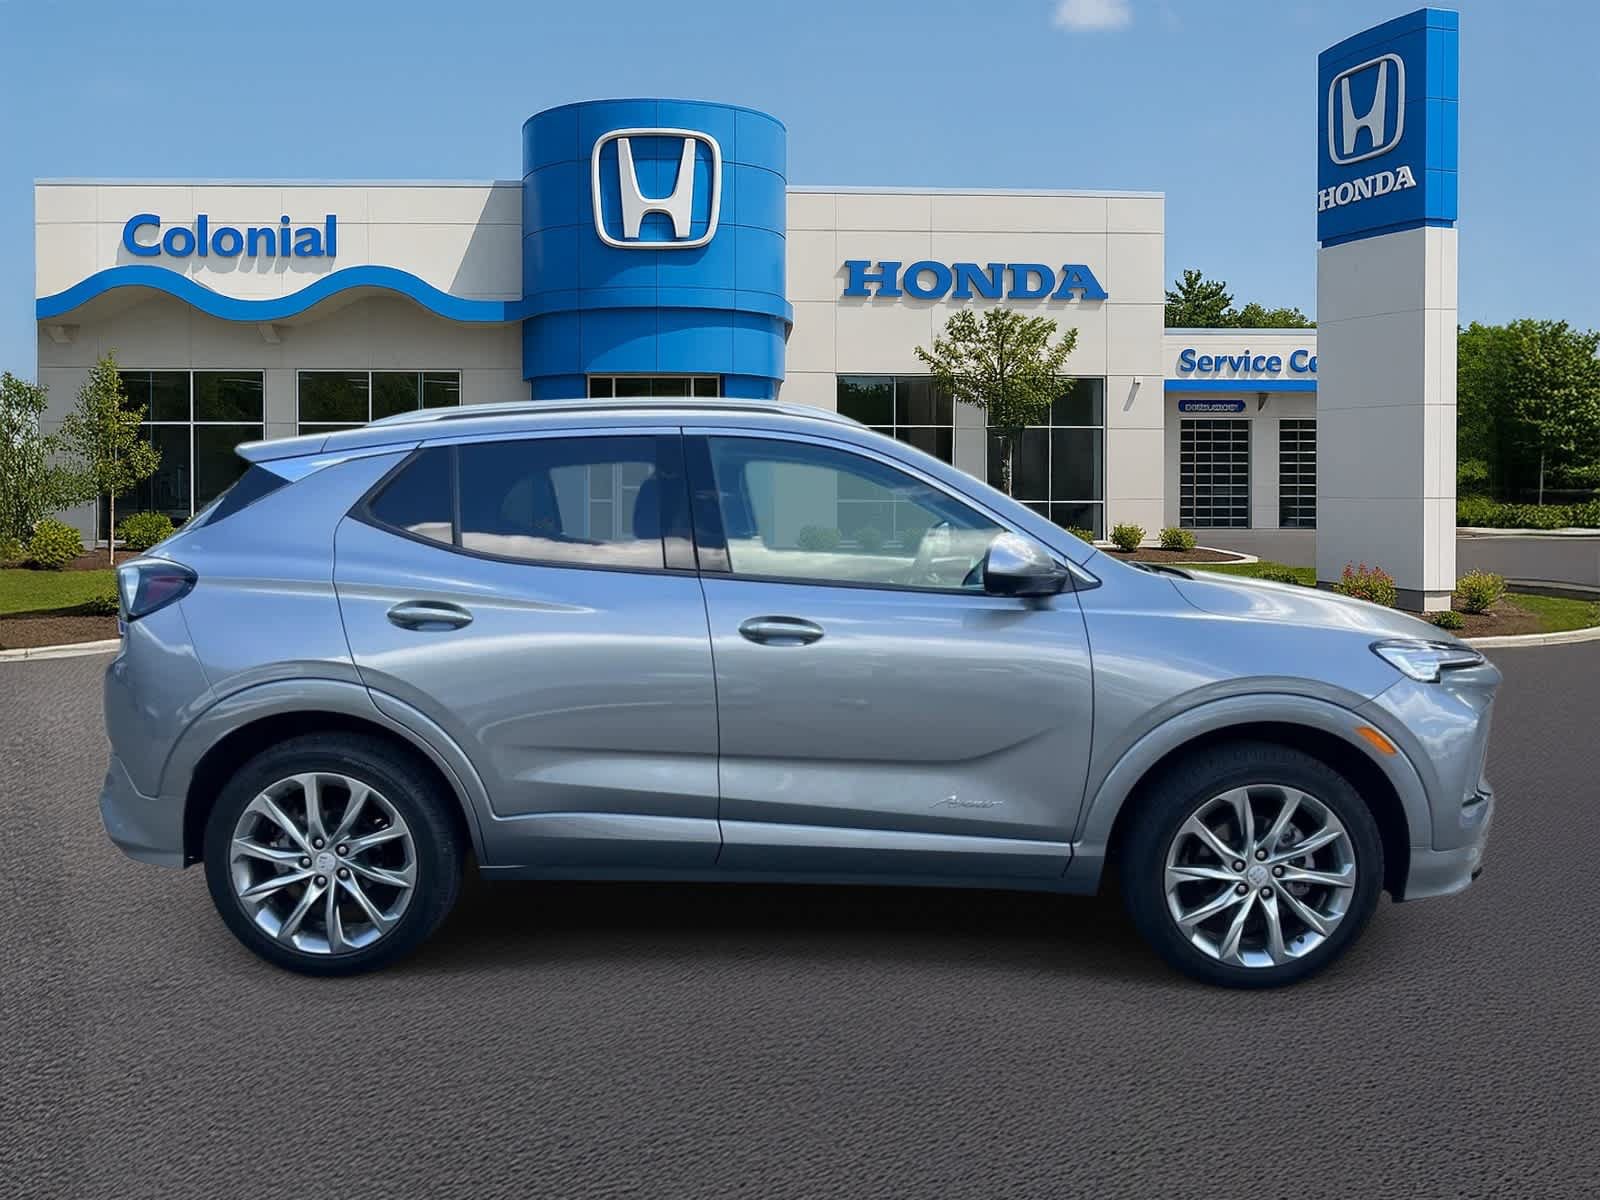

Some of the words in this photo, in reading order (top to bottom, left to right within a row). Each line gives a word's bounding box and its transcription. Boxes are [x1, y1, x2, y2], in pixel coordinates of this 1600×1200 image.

[1318, 165, 1417, 212] HONDA
[122, 213, 337, 258] Colonial
[843, 260, 1109, 300] HONDA
[1180, 348, 1282, 373] Service
